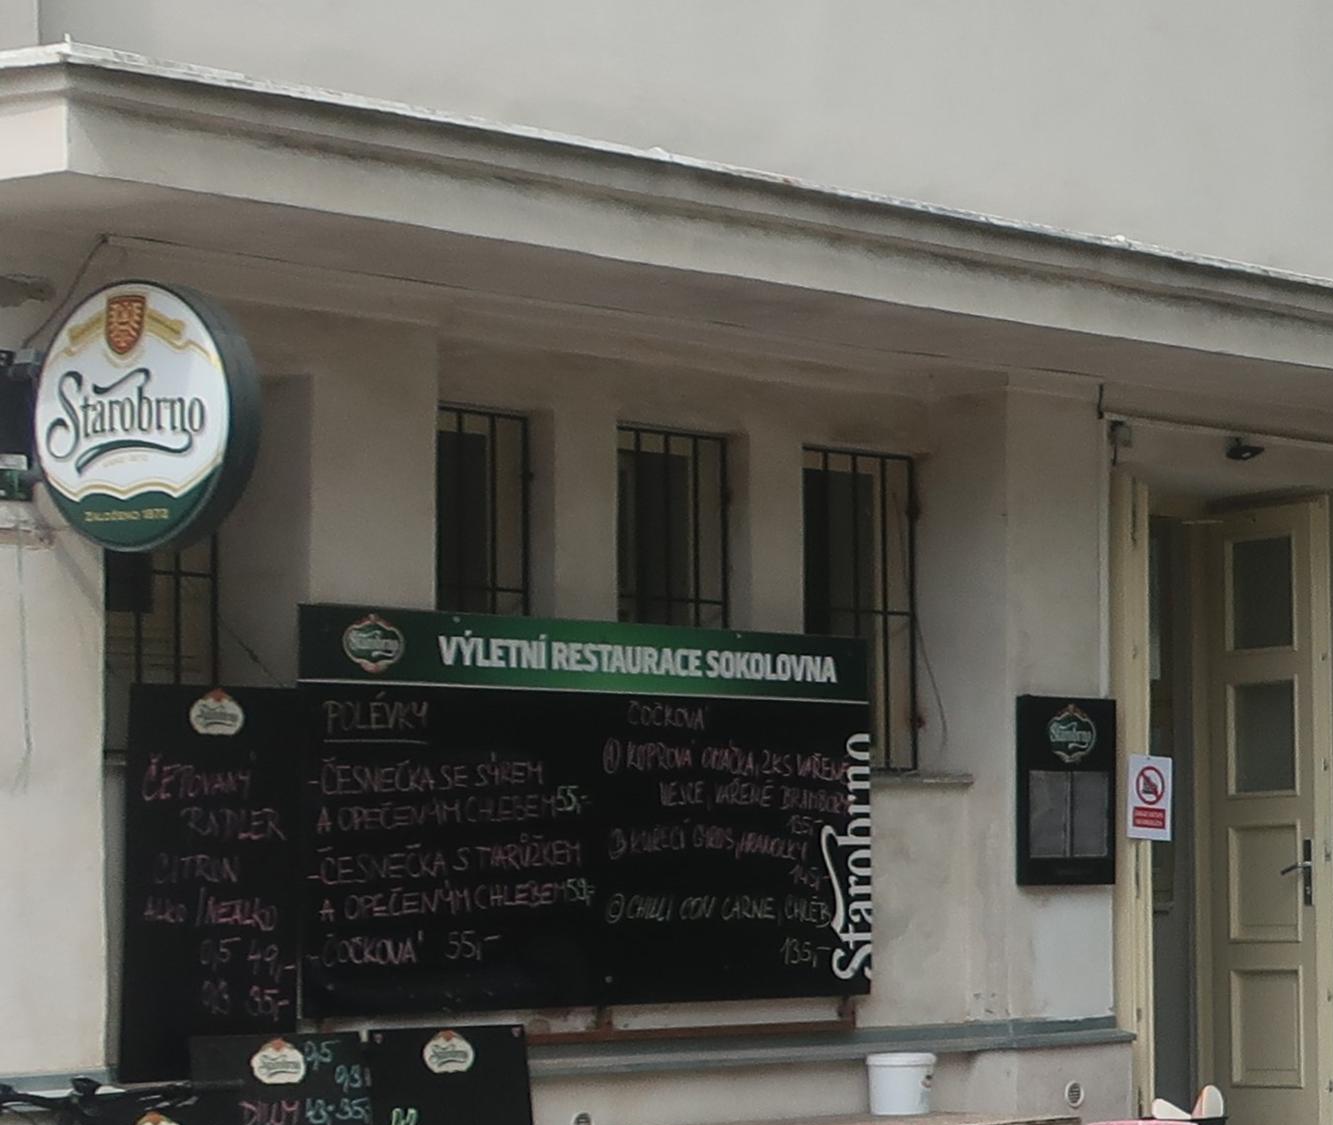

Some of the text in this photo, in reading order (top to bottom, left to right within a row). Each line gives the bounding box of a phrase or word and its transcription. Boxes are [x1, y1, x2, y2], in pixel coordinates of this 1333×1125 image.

[46, 367, 205, 477] Starobrno
[438, 629, 838, 683] VÝLETNÍ RESTAURACE SOKOLOVNA
[321, 691, 429, 733] POLÉVKY
[438, 765, 469, 791] SE
[475, 752, 545, 788] SÝREM
[316, 806, 333, 834] A
[452, 847, 472, 872] S
[319, 898, 336, 922] A
